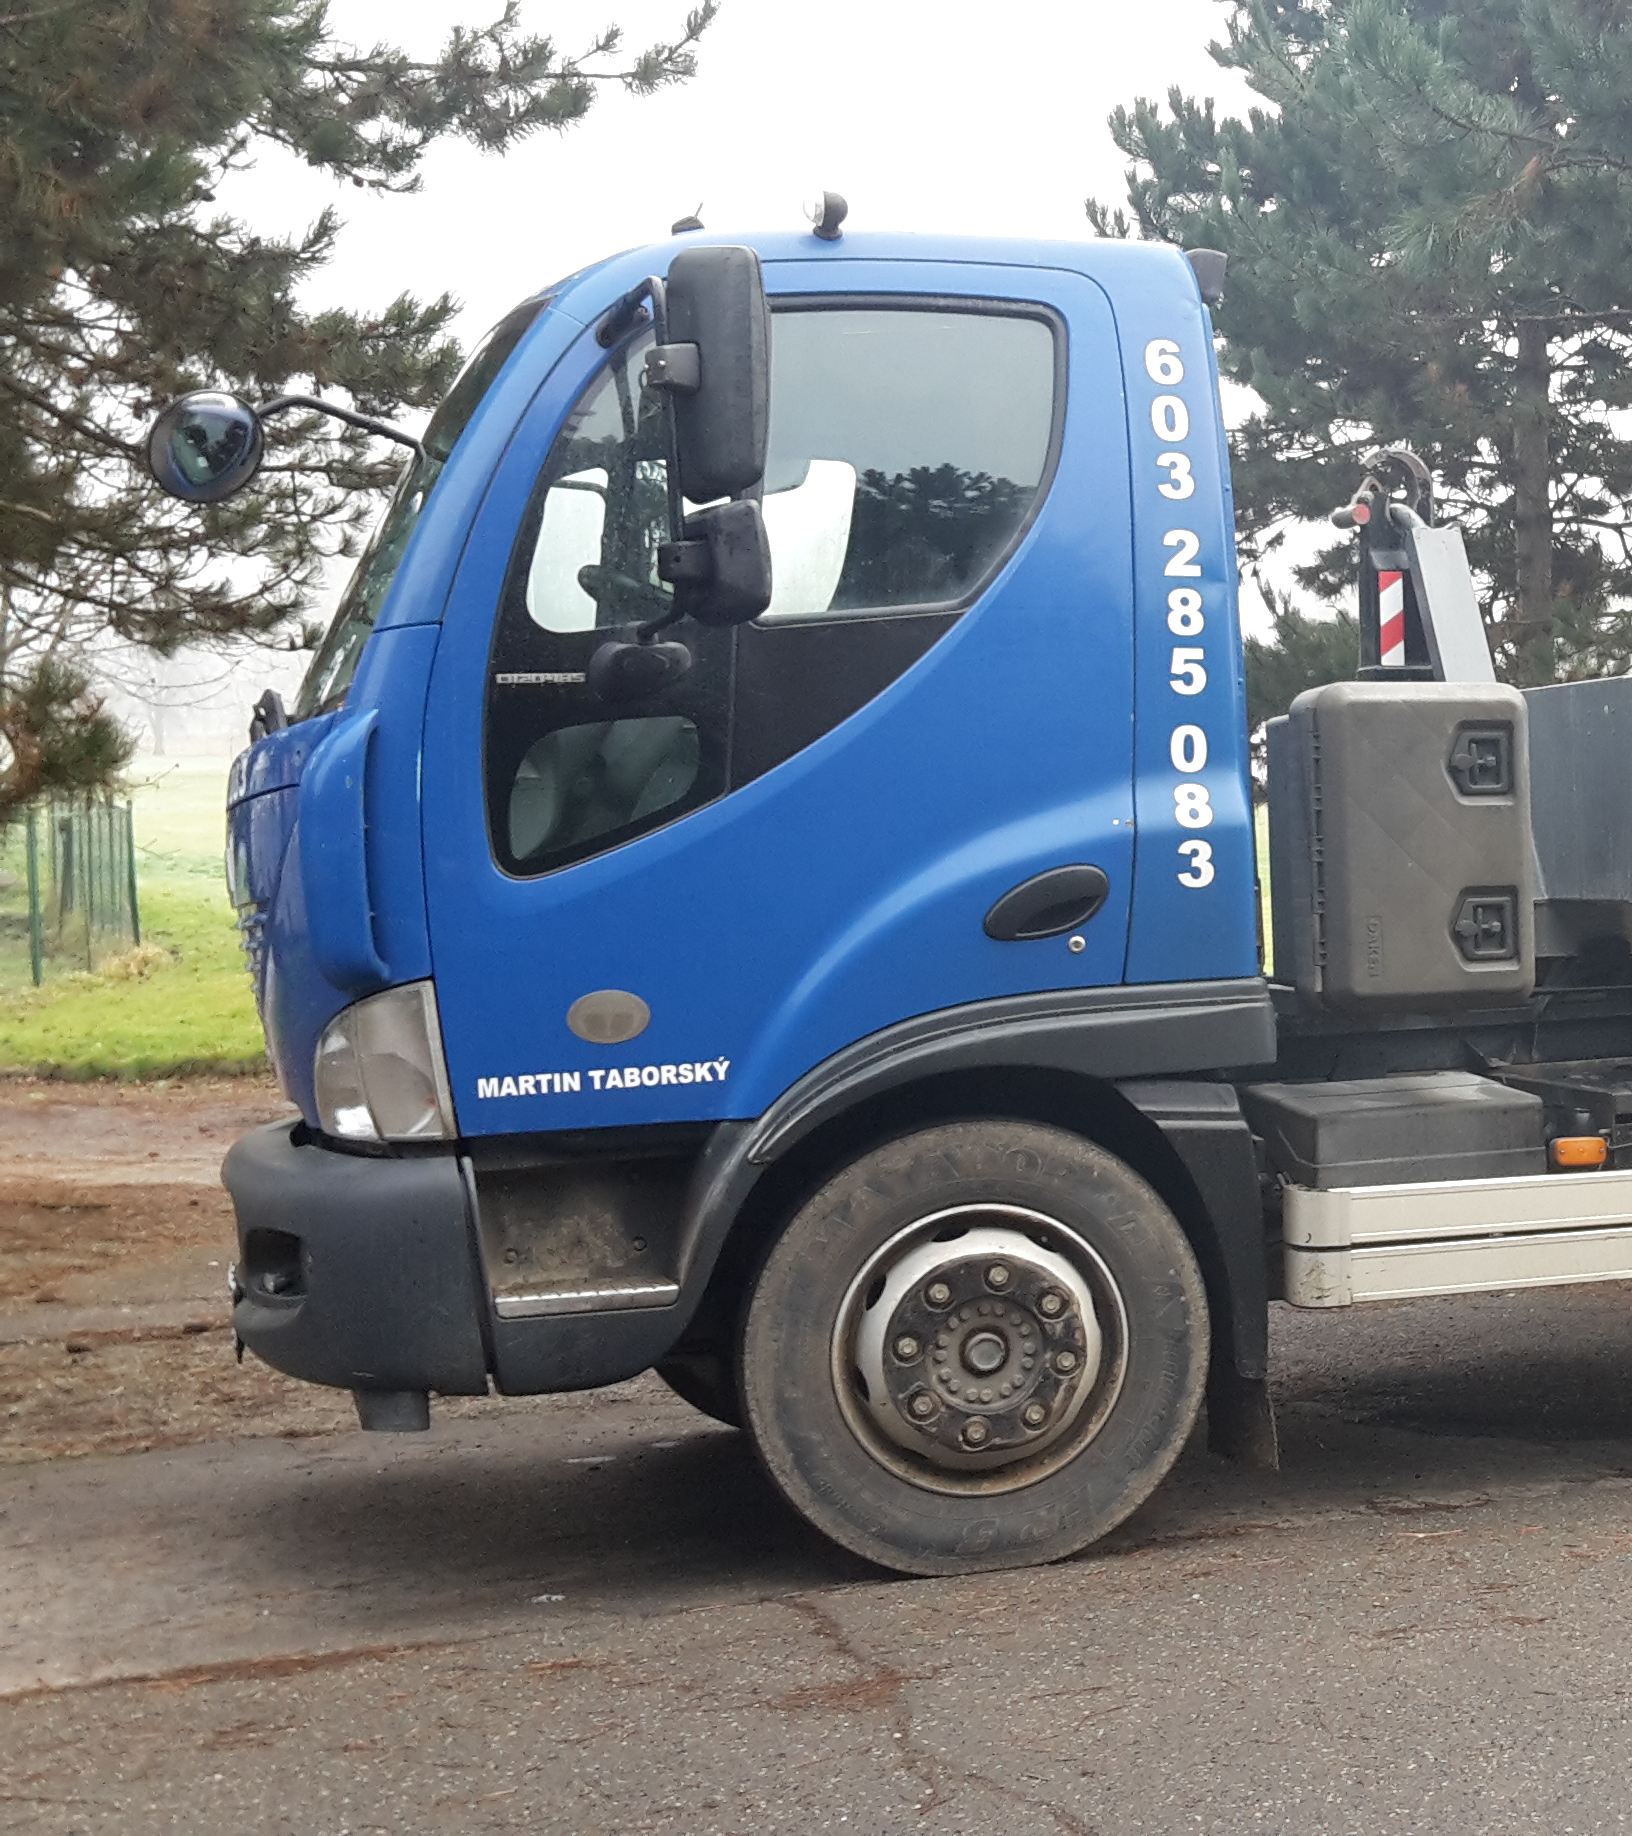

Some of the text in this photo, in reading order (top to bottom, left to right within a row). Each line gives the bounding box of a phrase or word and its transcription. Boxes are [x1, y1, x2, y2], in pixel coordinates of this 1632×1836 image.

[1144, 338, 1216, 889] 603 285 083
[477, 1056, 731, 1099] MARTIN TABORSKÝ
